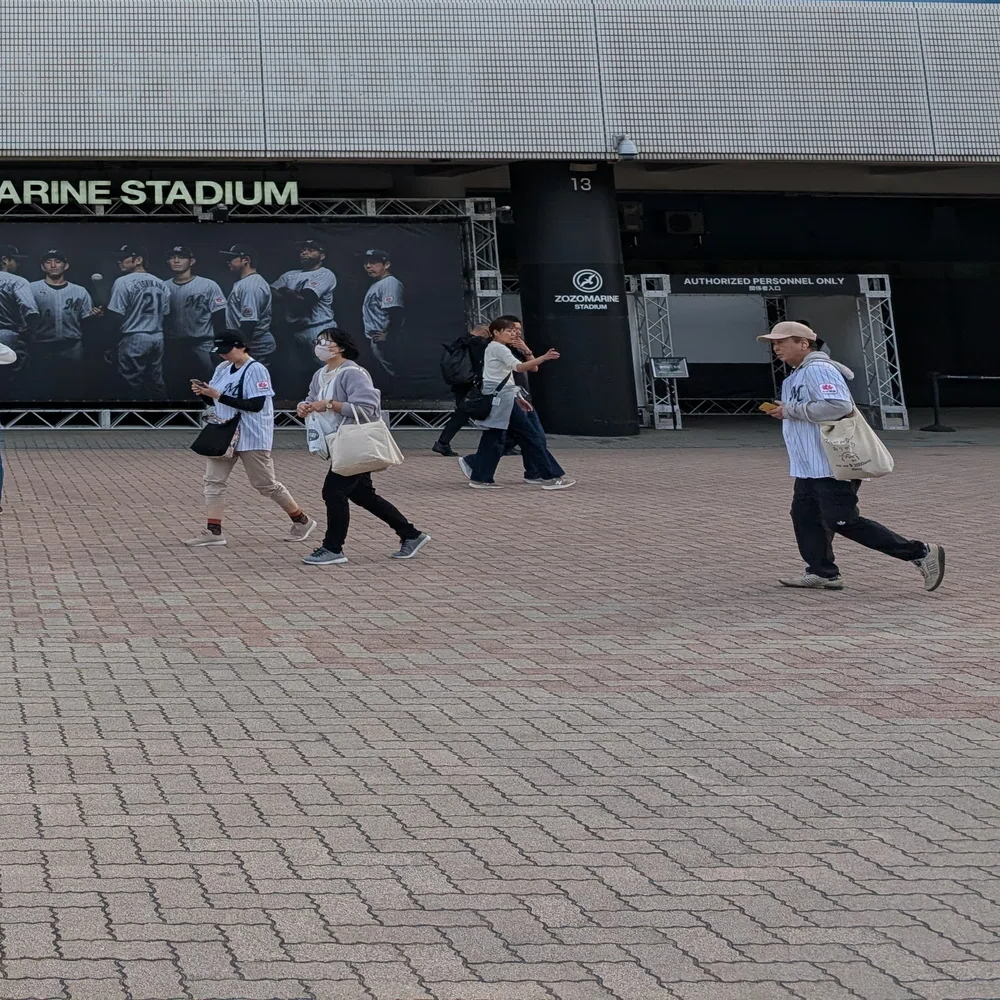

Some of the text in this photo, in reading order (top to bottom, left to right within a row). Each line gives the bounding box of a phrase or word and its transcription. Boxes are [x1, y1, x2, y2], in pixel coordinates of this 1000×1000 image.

[571, 178, 592, 191] 13
[120, 180, 299, 205] STADIUM
[684, 277, 845, 285] AUTHORIZED PERSONNEL ONLY
[554, 295, 620, 303] ZOZOMARINE
